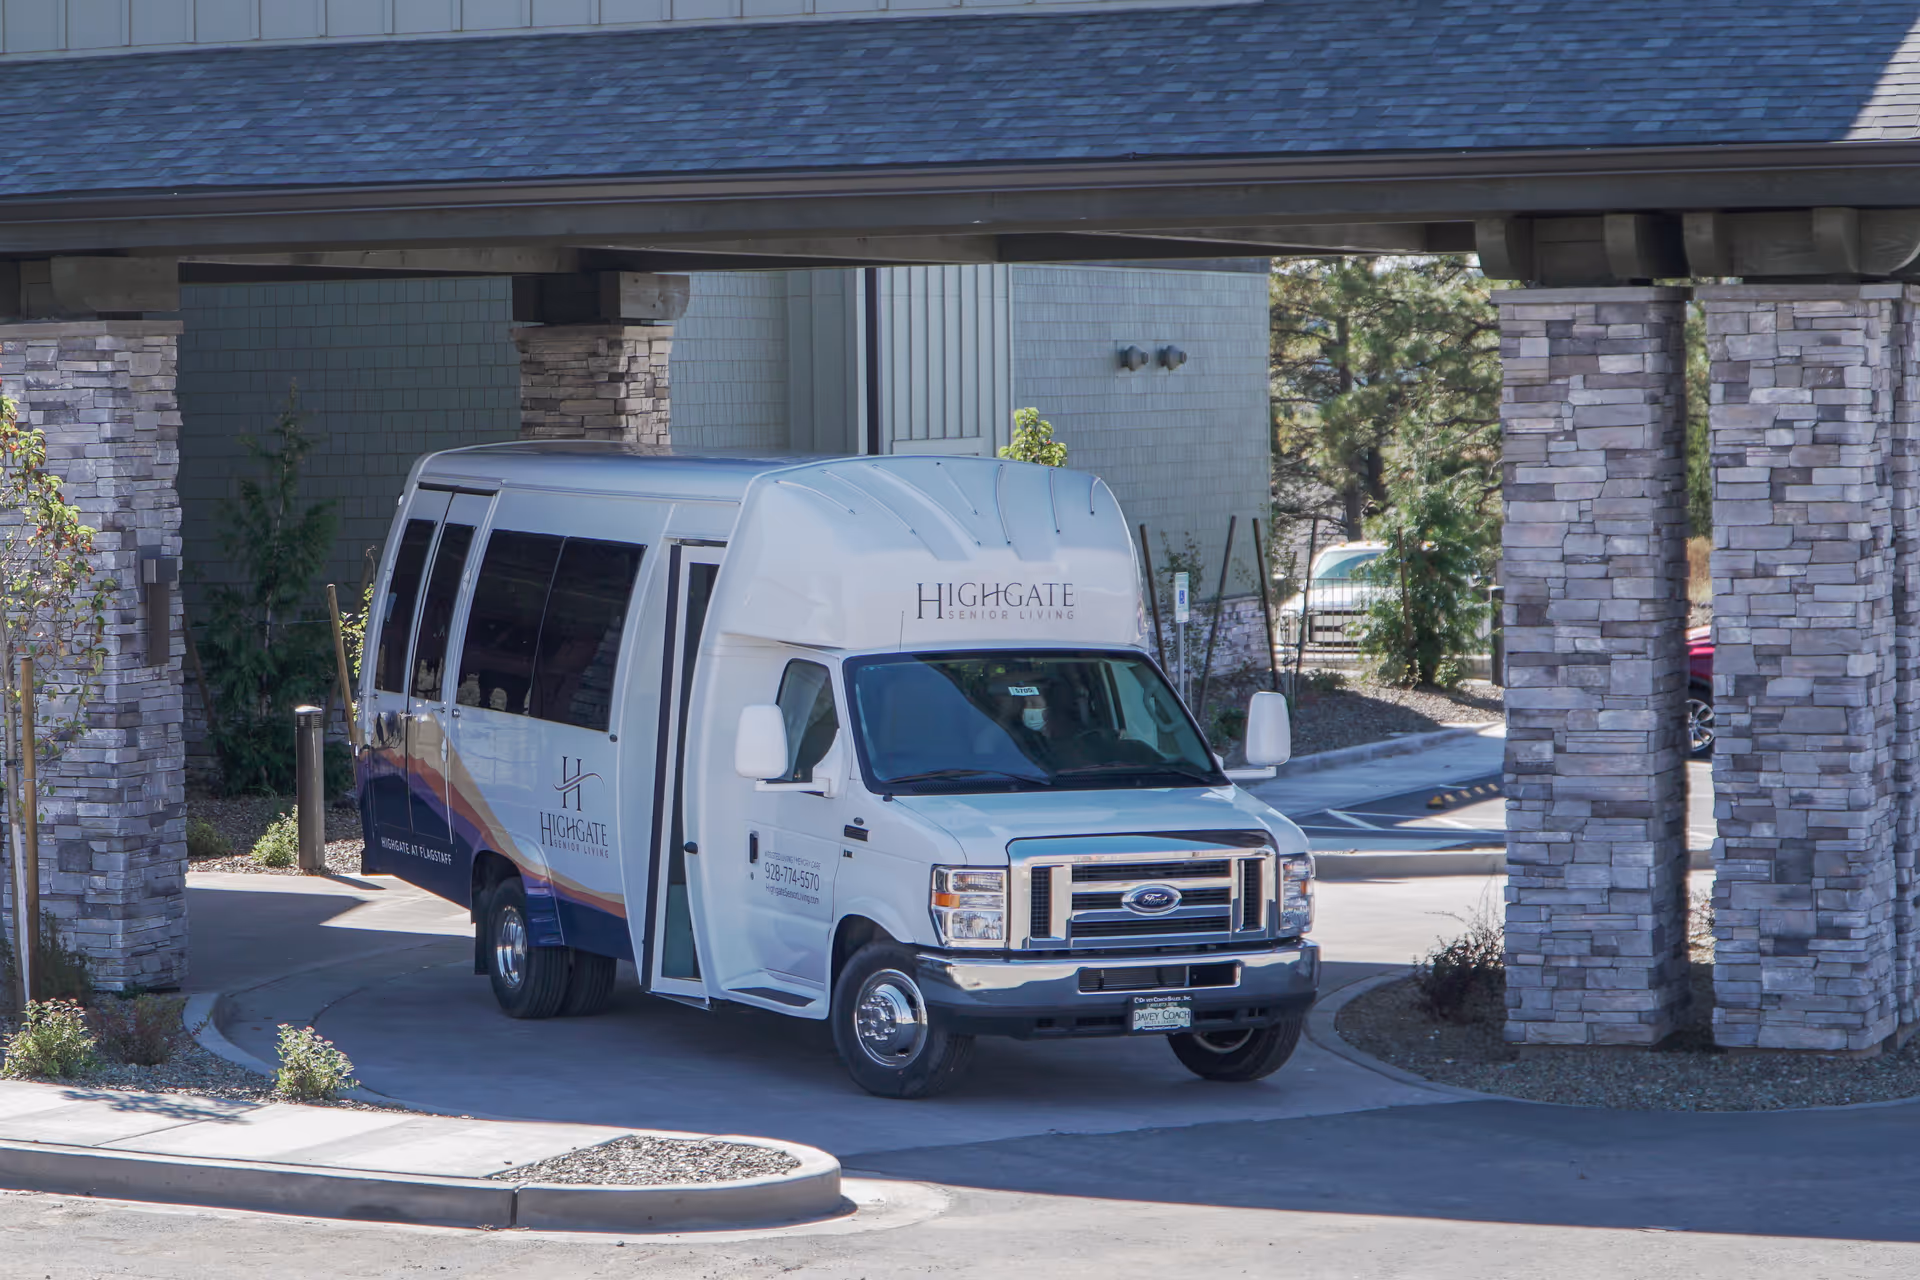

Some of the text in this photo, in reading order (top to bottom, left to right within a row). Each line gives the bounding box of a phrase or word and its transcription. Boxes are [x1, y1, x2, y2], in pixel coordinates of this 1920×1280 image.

[917, 582, 1074, 619] HIGHGATE
[949, 611, 1074, 619] SENIOR LIVING
[540, 811, 608, 847] HIGHGATE
[381, 837, 452, 865] HIGHGATE AT FLAGSTAFF
[554, 840, 609, 858] SENIOR LIVING
[765, 862, 820, 891] 928-774-5570
[1142, 893, 1168, 905] Ford
[1134, 1010, 1191, 1022] DAVEY COACH
